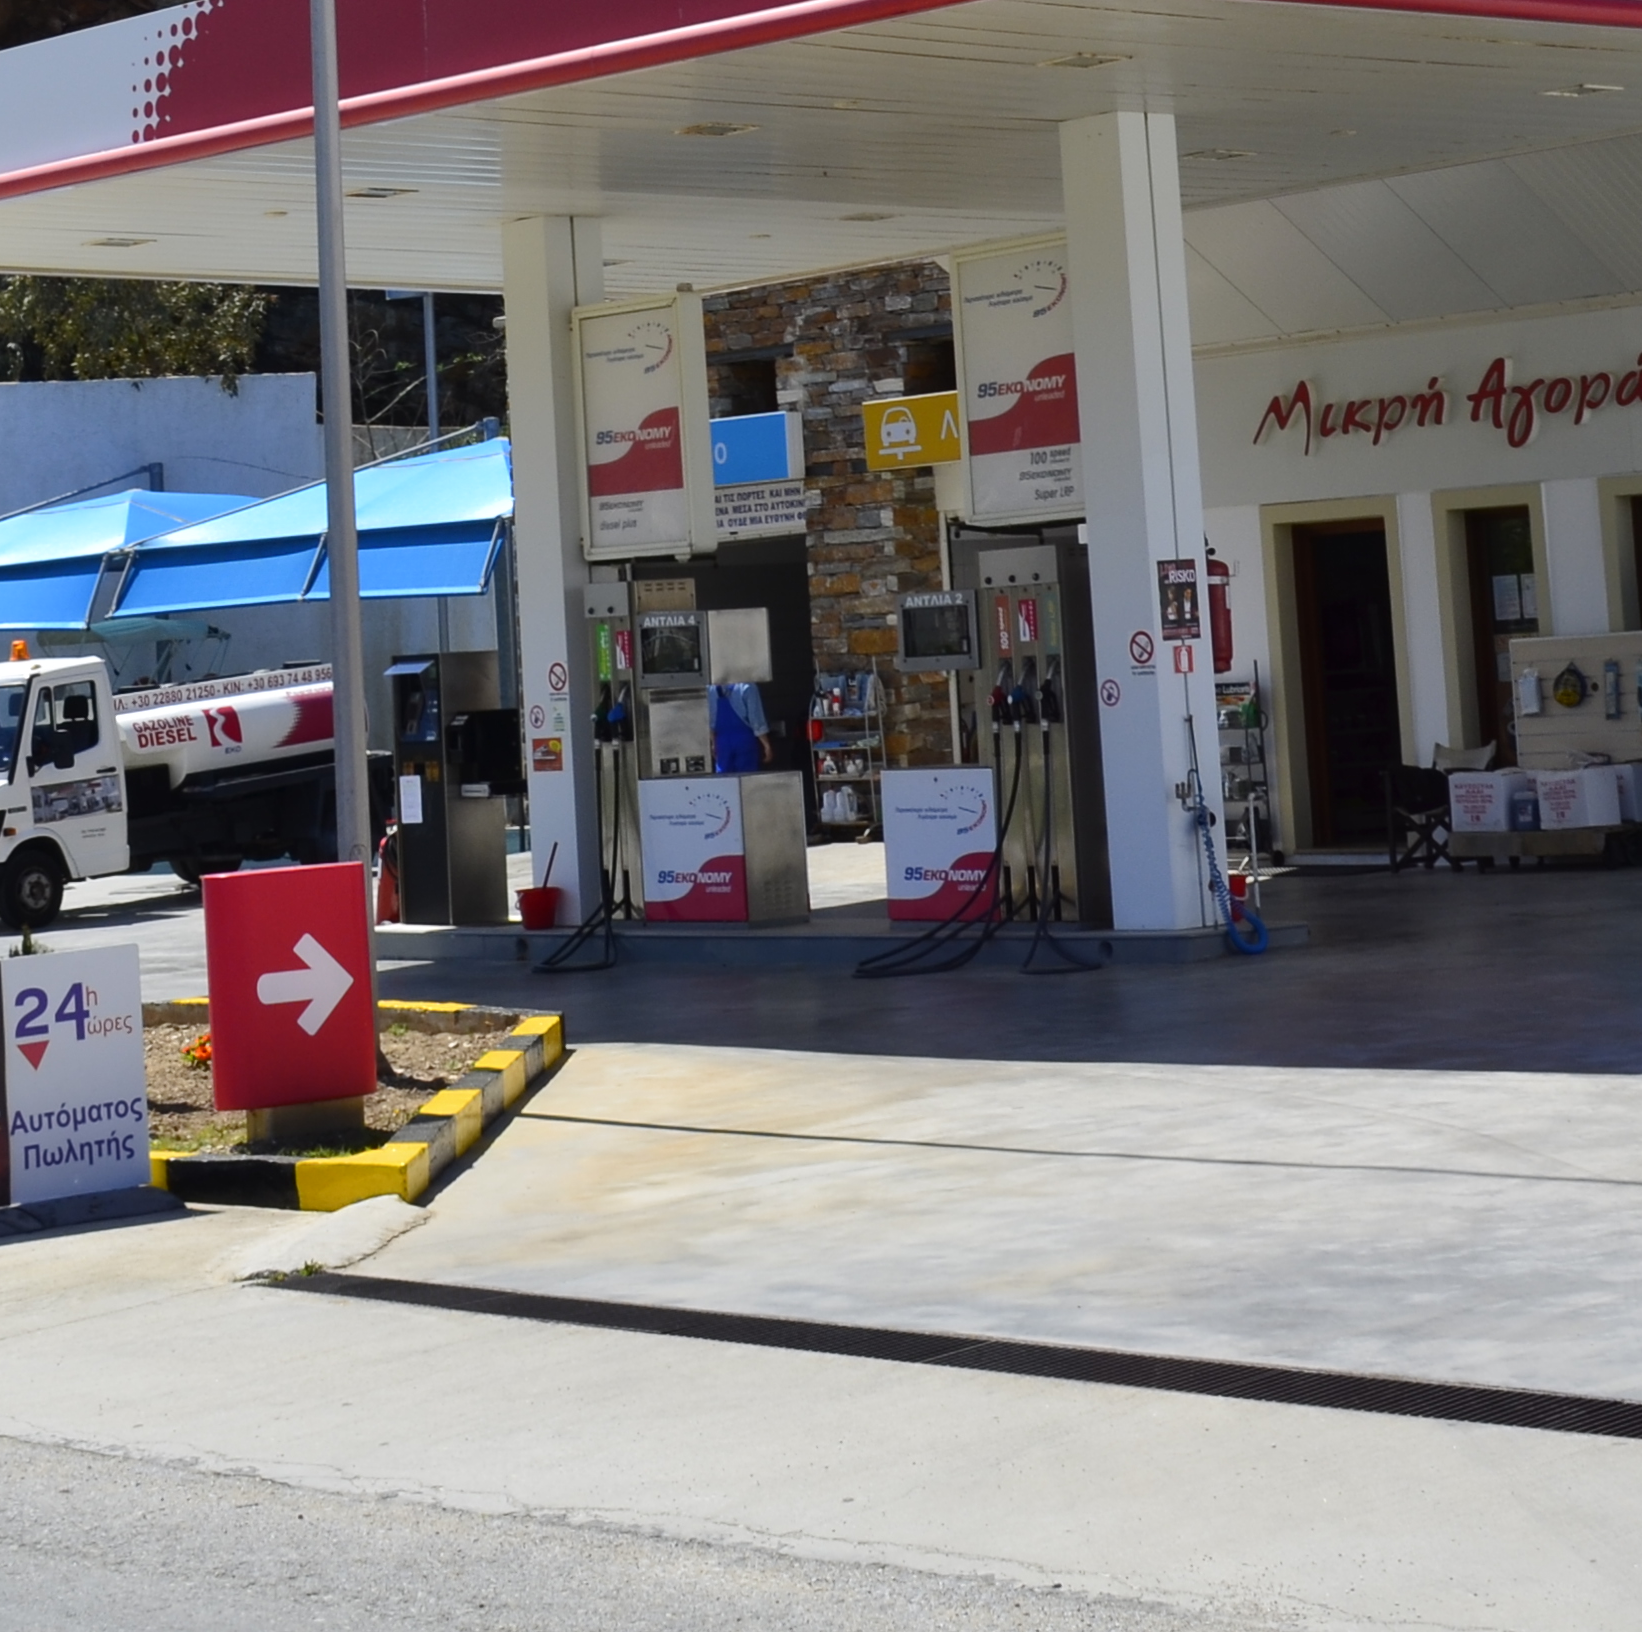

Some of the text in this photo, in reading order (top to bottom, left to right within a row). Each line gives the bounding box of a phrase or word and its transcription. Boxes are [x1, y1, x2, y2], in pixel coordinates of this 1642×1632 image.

[977, 374, 1067, 399] 95EKONOMY
[1253, 376, 1446, 456] Μικρή
[596, 426, 672, 445] 95EKONOMY
[1030, 451, 1047, 465] 100
[1035, 488, 1059, 501] Super
[905, 593, 964, 608] ΑΝΤΛΙΑ 2
[643, 615, 696, 628] ΑΝΤΛΙΑ 4
[131, 695, 150, 708] +30
[153, 690, 183, 705] 22880
[186, 685, 215, 700] 21250
[248, 677, 265, 689] +30
[267, 674, 284, 688] 693
[288, 672, 299, 685] 74
[301, 669, 312, 682] 48
[315, 667, 333, 681] 956
[132, 714, 195, 733] GAZOLINE
[137, 727, 198, 749] DIESEL
[225, 745, 242, 754] EKO
[657, 870, 733, 885] 95EKONOMY
[904, 867, 988, 881] 95EKONOMY
[14, 982, 98, 1041] 24 h
[87, 1015, 133, 1037] ώρες
[10, 1097, 144, 1136] Αυτόματος
[24, 1131, 135, 1170] Πωλητής
